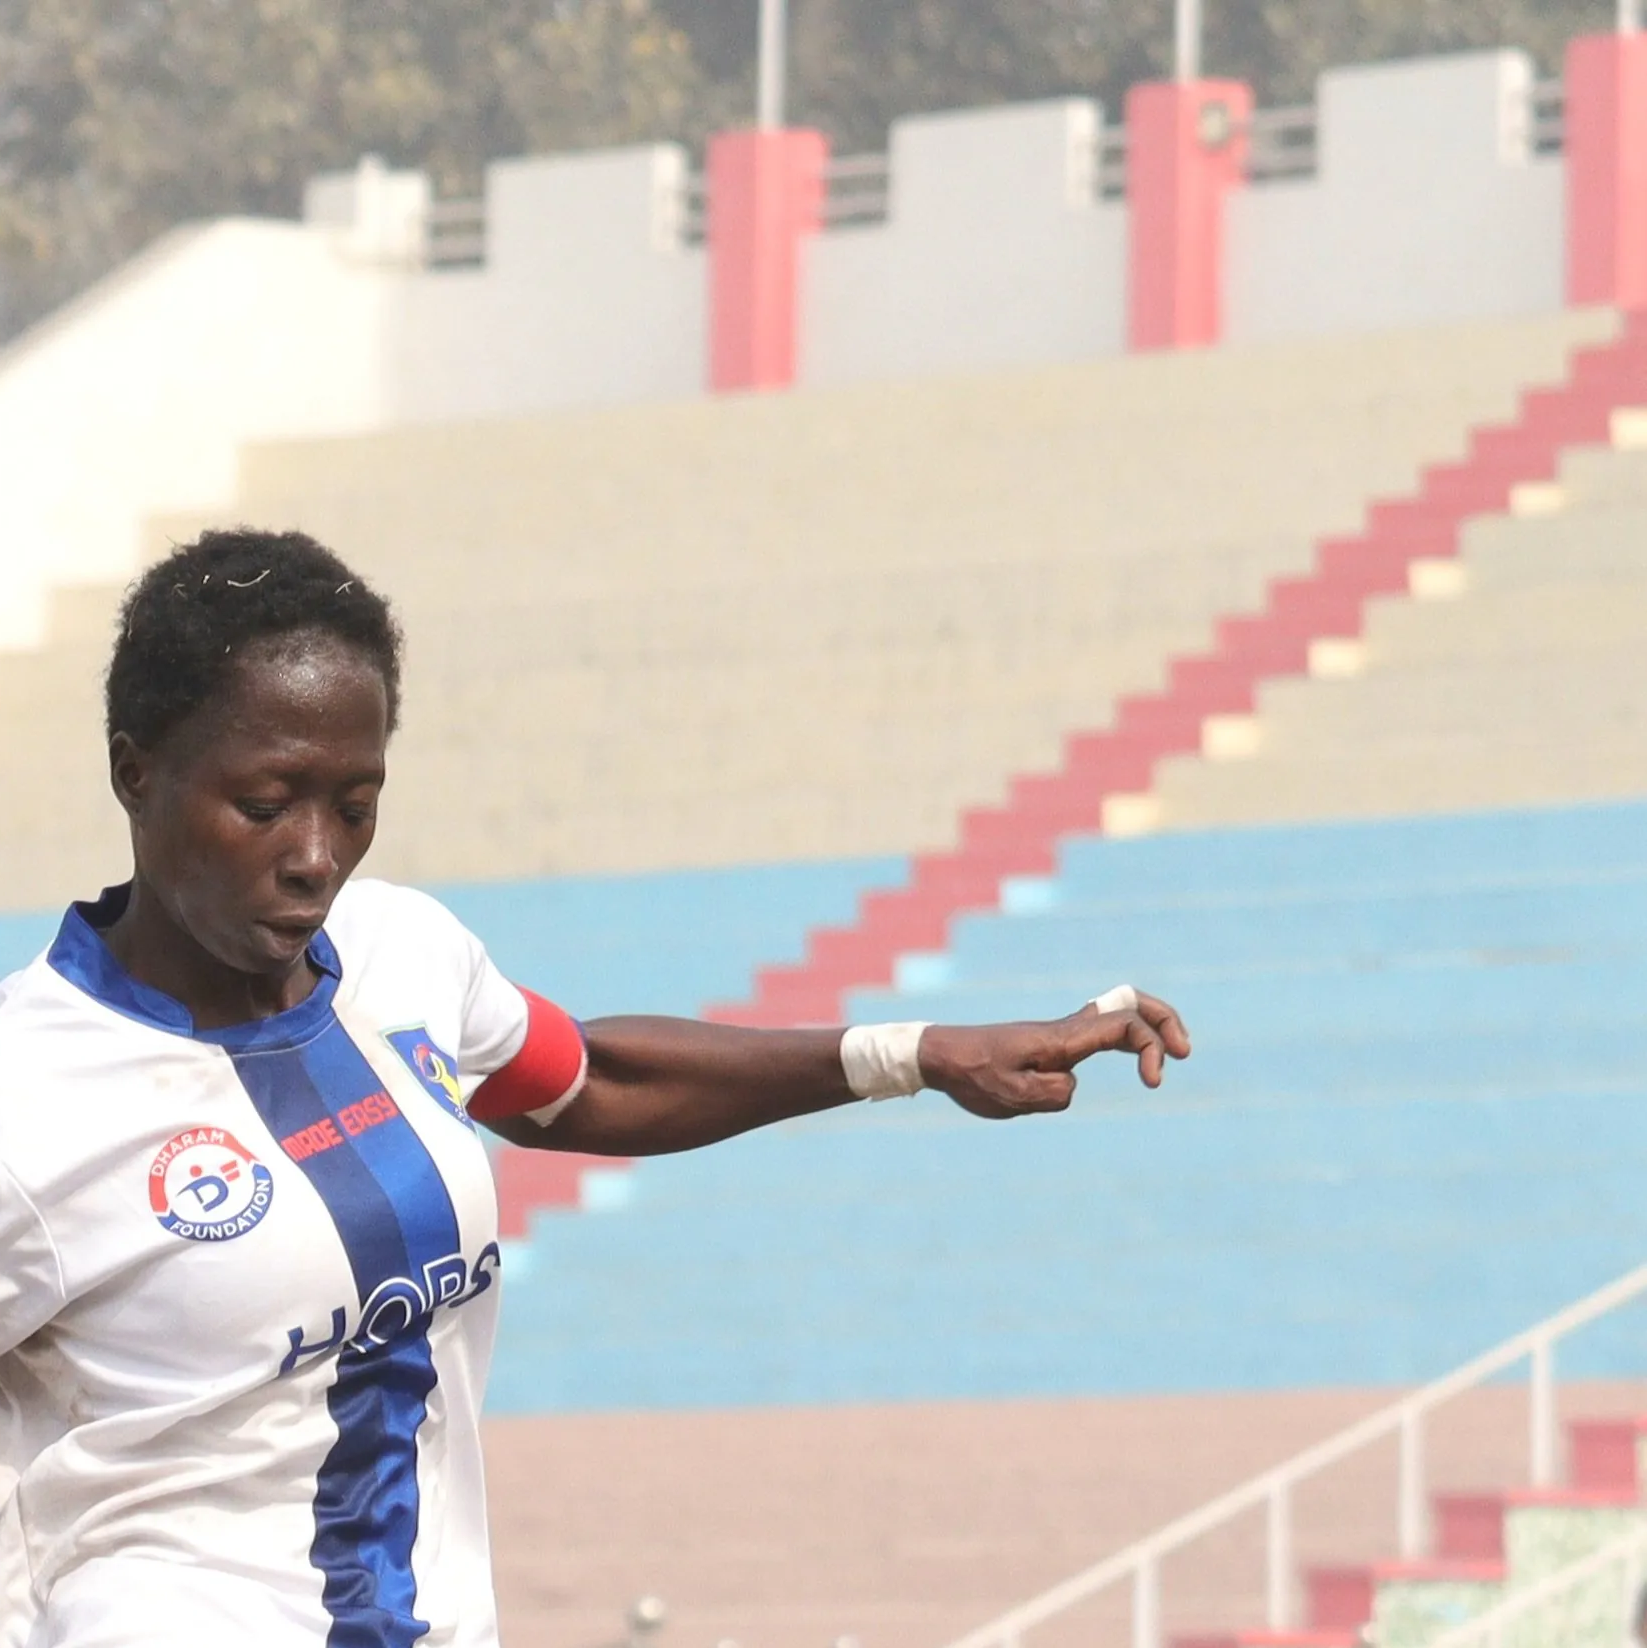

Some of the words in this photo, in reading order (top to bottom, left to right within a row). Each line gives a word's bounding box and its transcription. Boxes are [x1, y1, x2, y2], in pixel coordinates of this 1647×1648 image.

[152, 1130, 225, 1176] DHARAM
[280, 1117, 345, 1162] MADE
[170, 1178, 271, 1239] FOUNDATION
